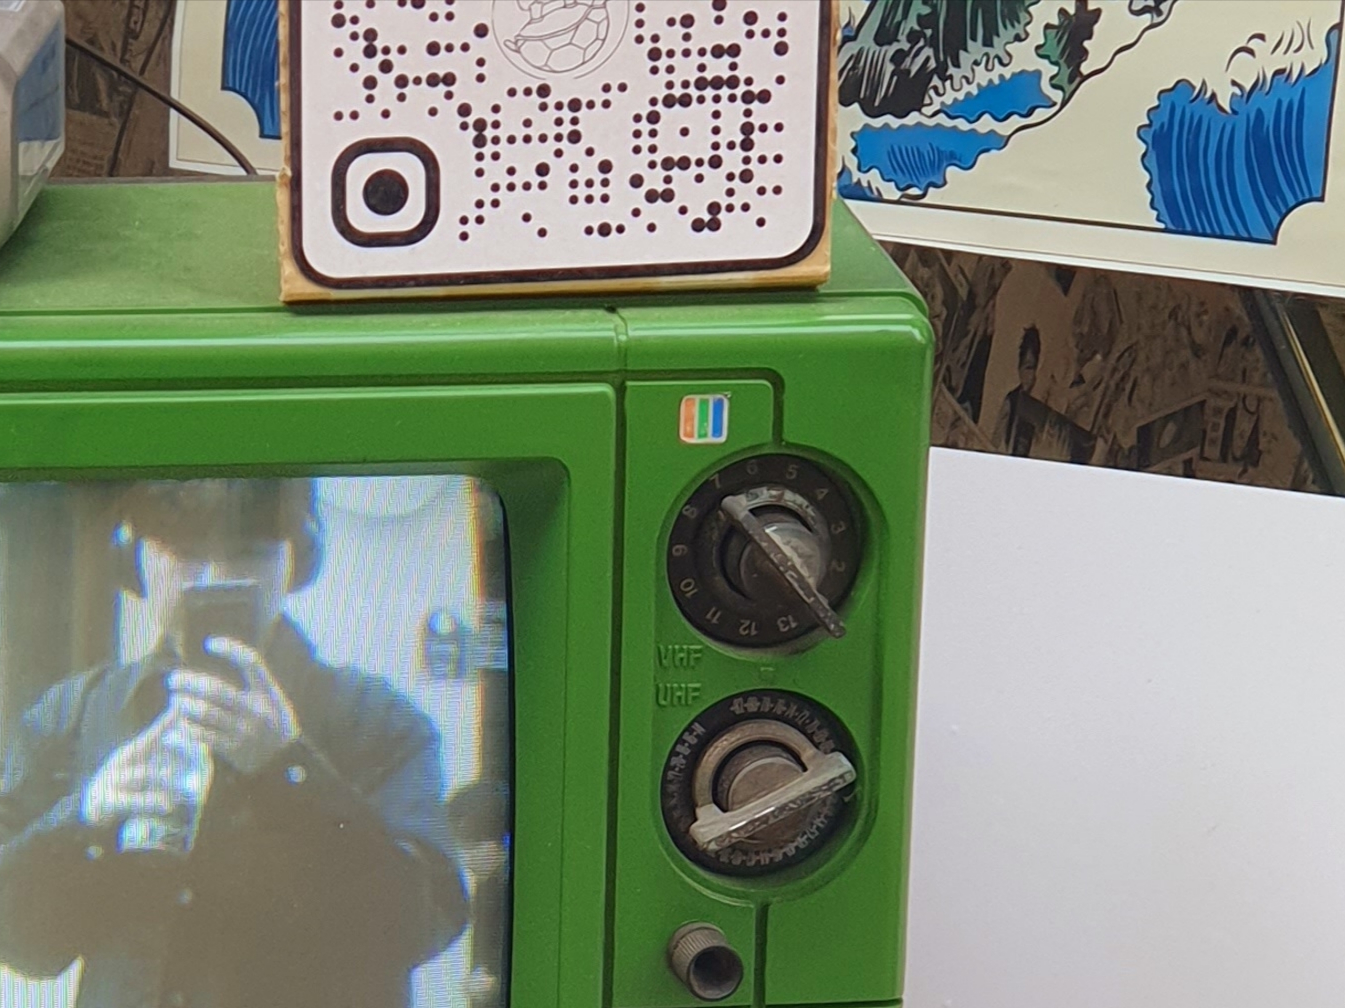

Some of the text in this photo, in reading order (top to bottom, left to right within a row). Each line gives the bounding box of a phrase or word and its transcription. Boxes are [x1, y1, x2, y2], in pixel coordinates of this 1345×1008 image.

[830, 561, 846, 573] 2
[679, 577, 699, 598] 10
[705, 606, 723, 624] 11
[776, 613, 799, 633] 13
[738, 618, 759, 636] 12
[656, 645, 703, 669] VHF
[656, 683, 702, 708] UHF
